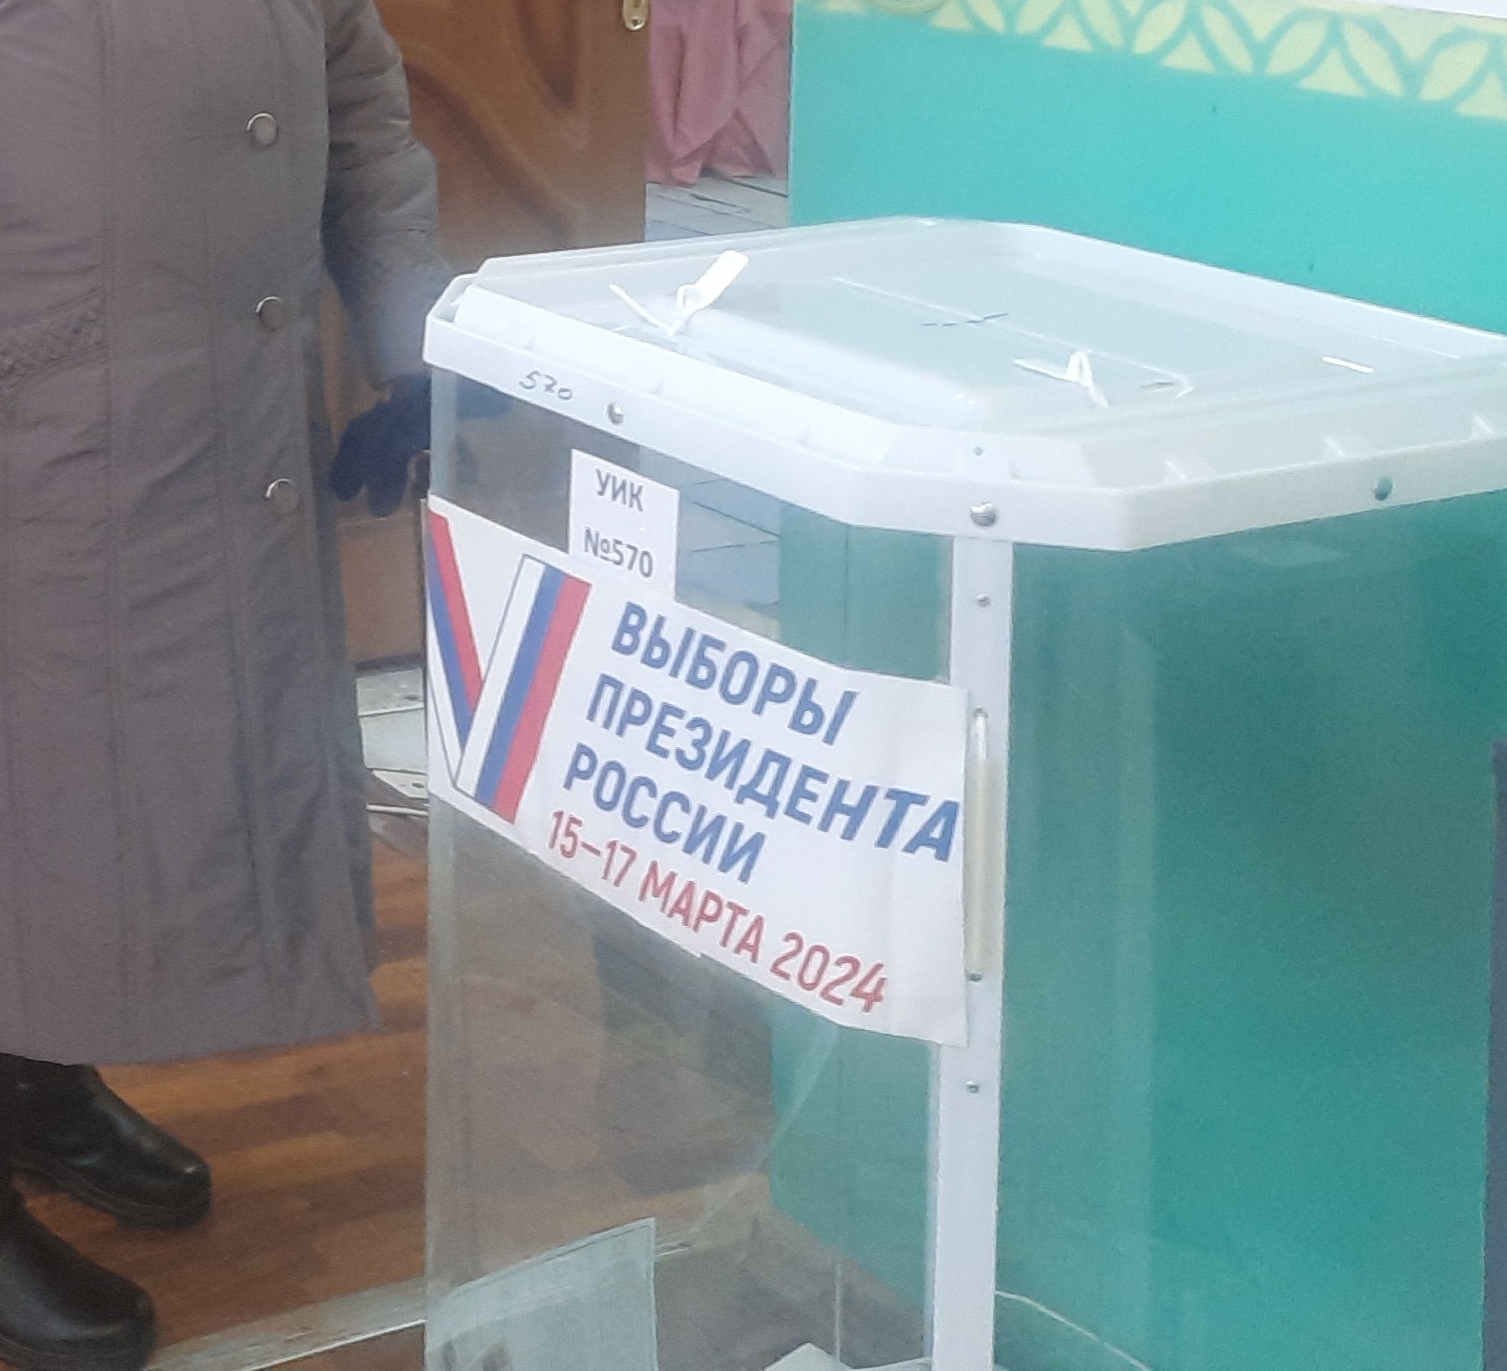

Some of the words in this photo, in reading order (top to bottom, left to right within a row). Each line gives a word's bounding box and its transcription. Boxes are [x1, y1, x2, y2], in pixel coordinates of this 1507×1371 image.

[519, 370, 574, 401] 570
[584, 526, 654, 578] №570
[596, 468, 644, 512] УИК
[610, 601, 859, 745] ВЫБОРЫ
[562, 742, 767, 885] РОССИИ
[586, 673, 960, 862] ПРЕЗИДЕНТА
[639, 860, 766, 964] МАРТА
[770, 931, 889, 1014] 2024
